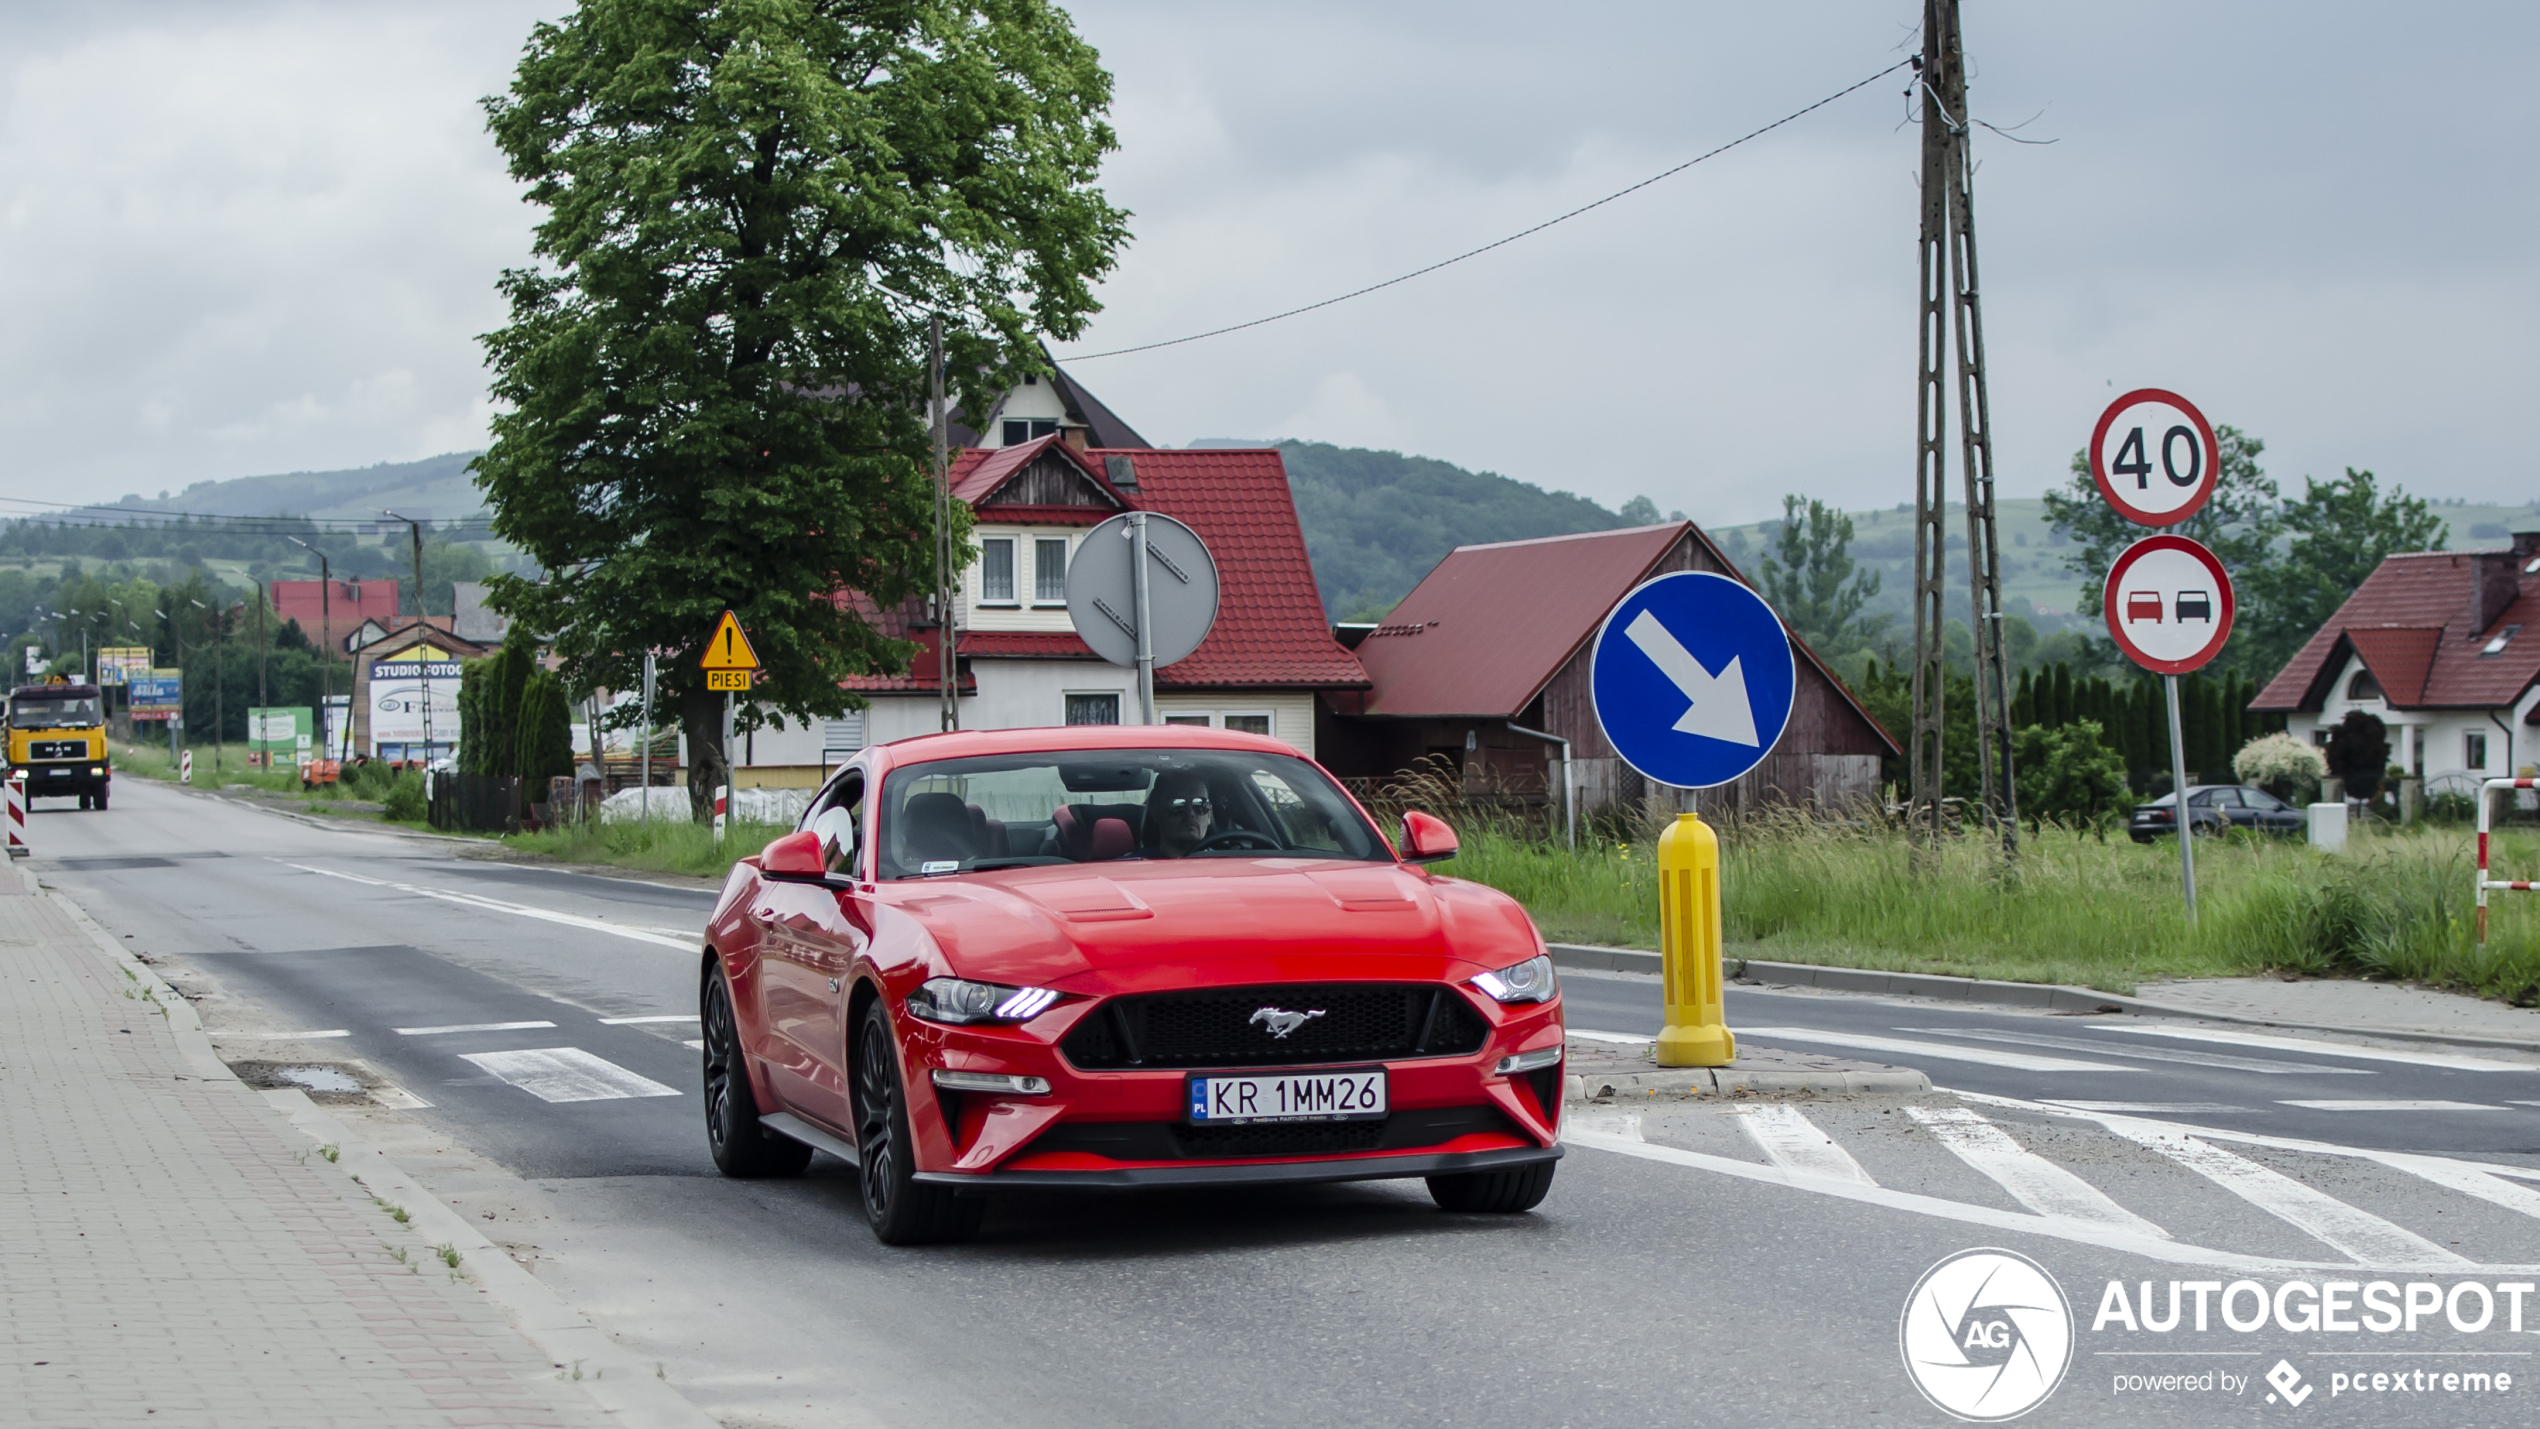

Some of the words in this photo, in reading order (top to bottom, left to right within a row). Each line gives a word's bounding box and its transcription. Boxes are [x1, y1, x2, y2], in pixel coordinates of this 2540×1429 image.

[2112, 425, 2202, 490] 40
[375, 664, 421, 678] STUDIO
[711, 673, 746, 688] PIESI
[1194, 1103, 1206, 1114] PL
[1215, 1081, 1258, 1115] KR
[1275, 1077, 1377, 1112] 1MM26
